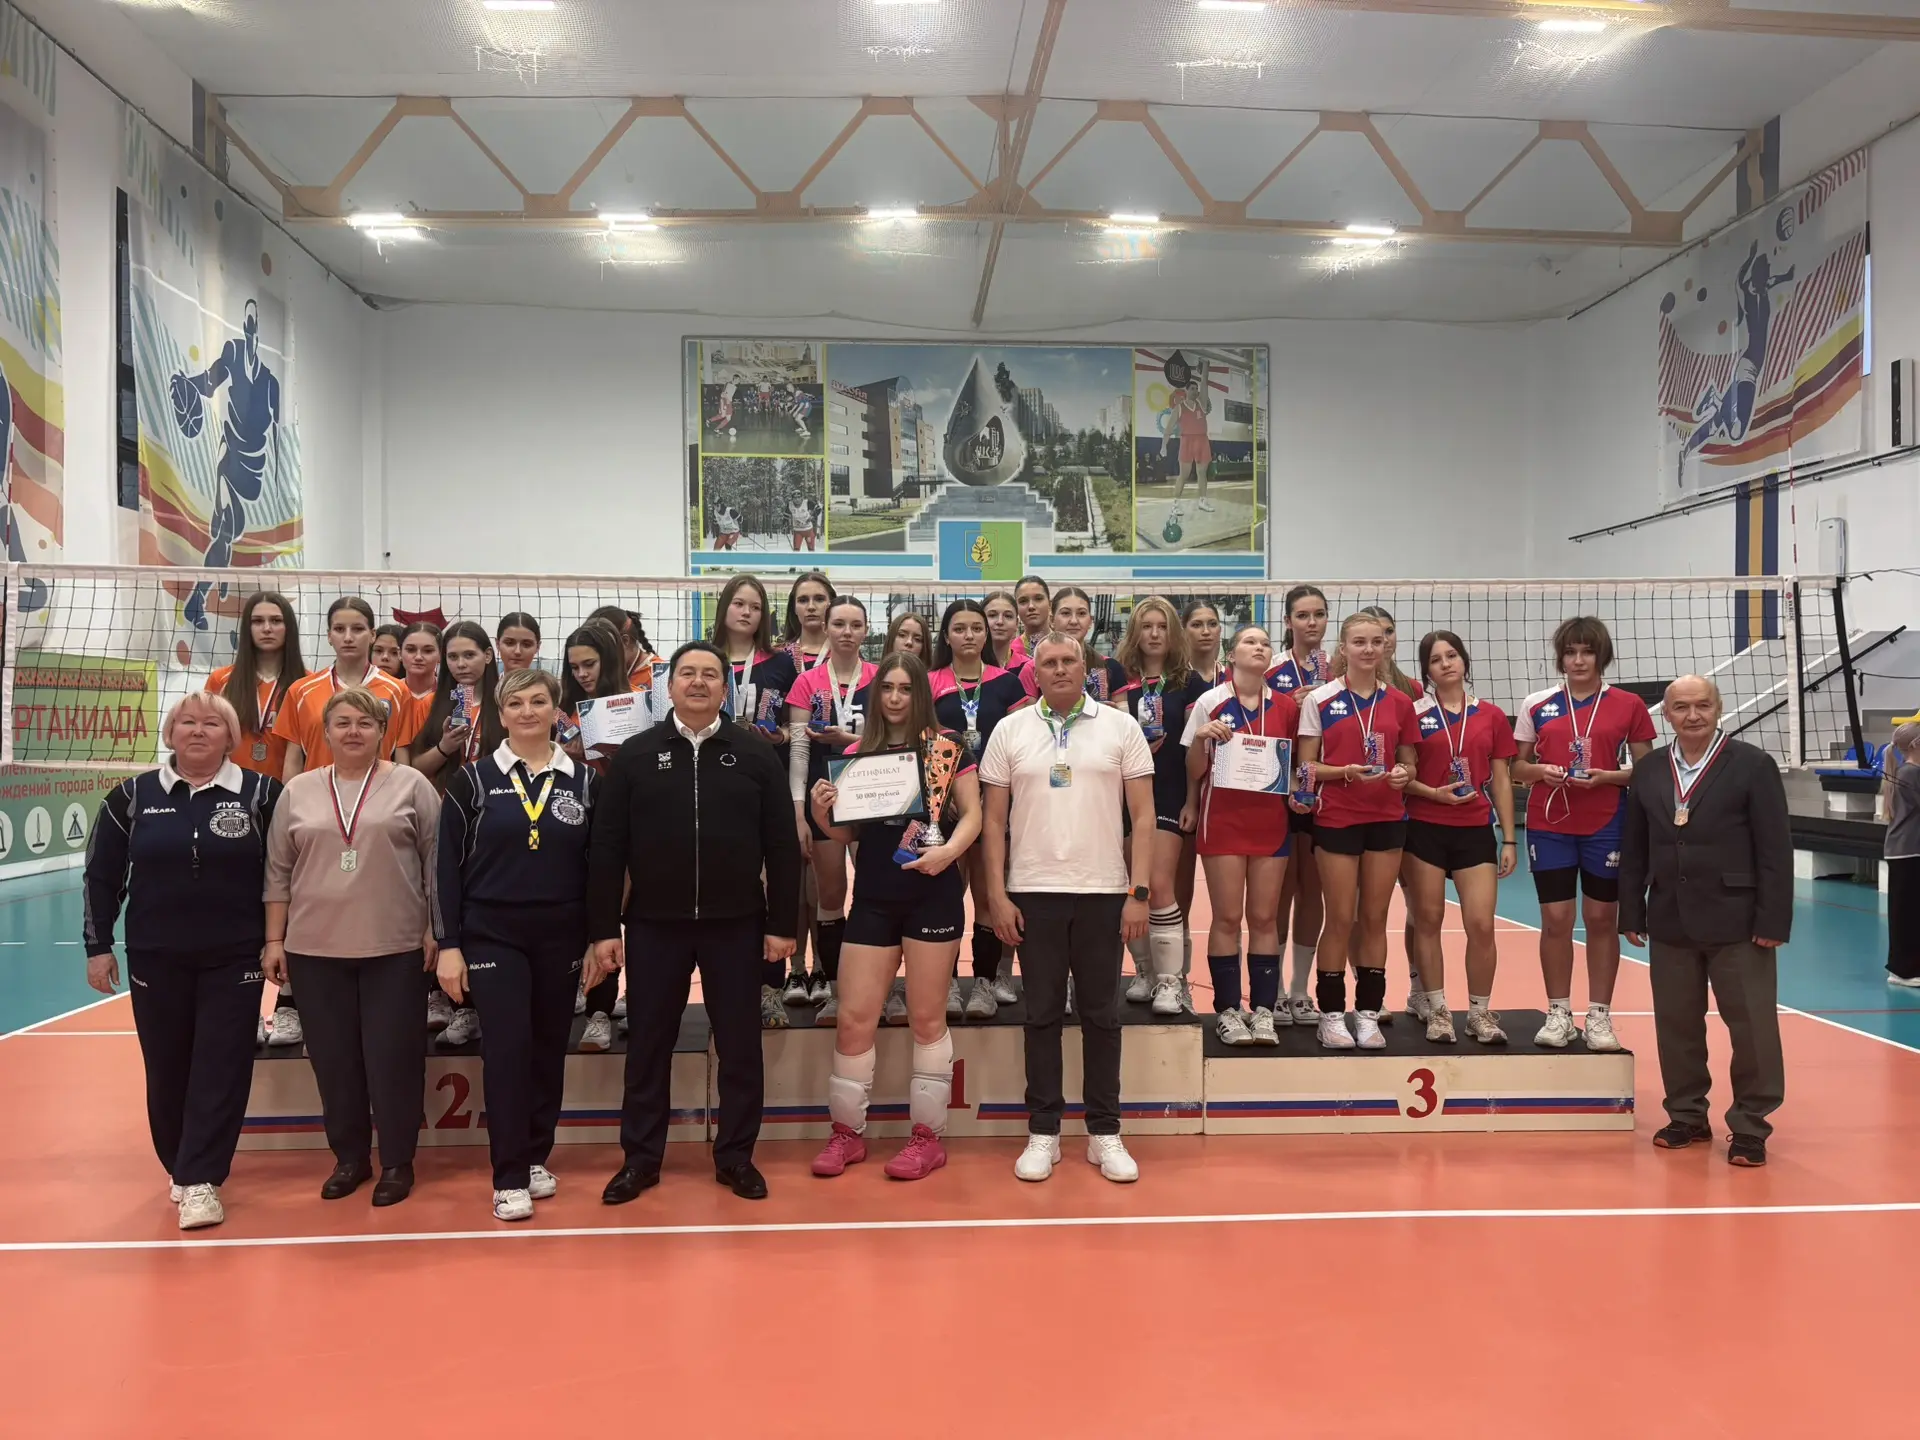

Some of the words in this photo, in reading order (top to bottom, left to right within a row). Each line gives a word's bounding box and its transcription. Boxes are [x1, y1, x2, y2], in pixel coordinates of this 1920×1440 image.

[0, 778, 51, 800] ждений
[54, 780, 94, 797] города
[846, 766, 901, 778] СЕРТИФИКАТ
[434, 1072, 472, 1129] 2
[947, 1058, 971, 1109] 1
[1406, 1068, 1438, 1118] 3
